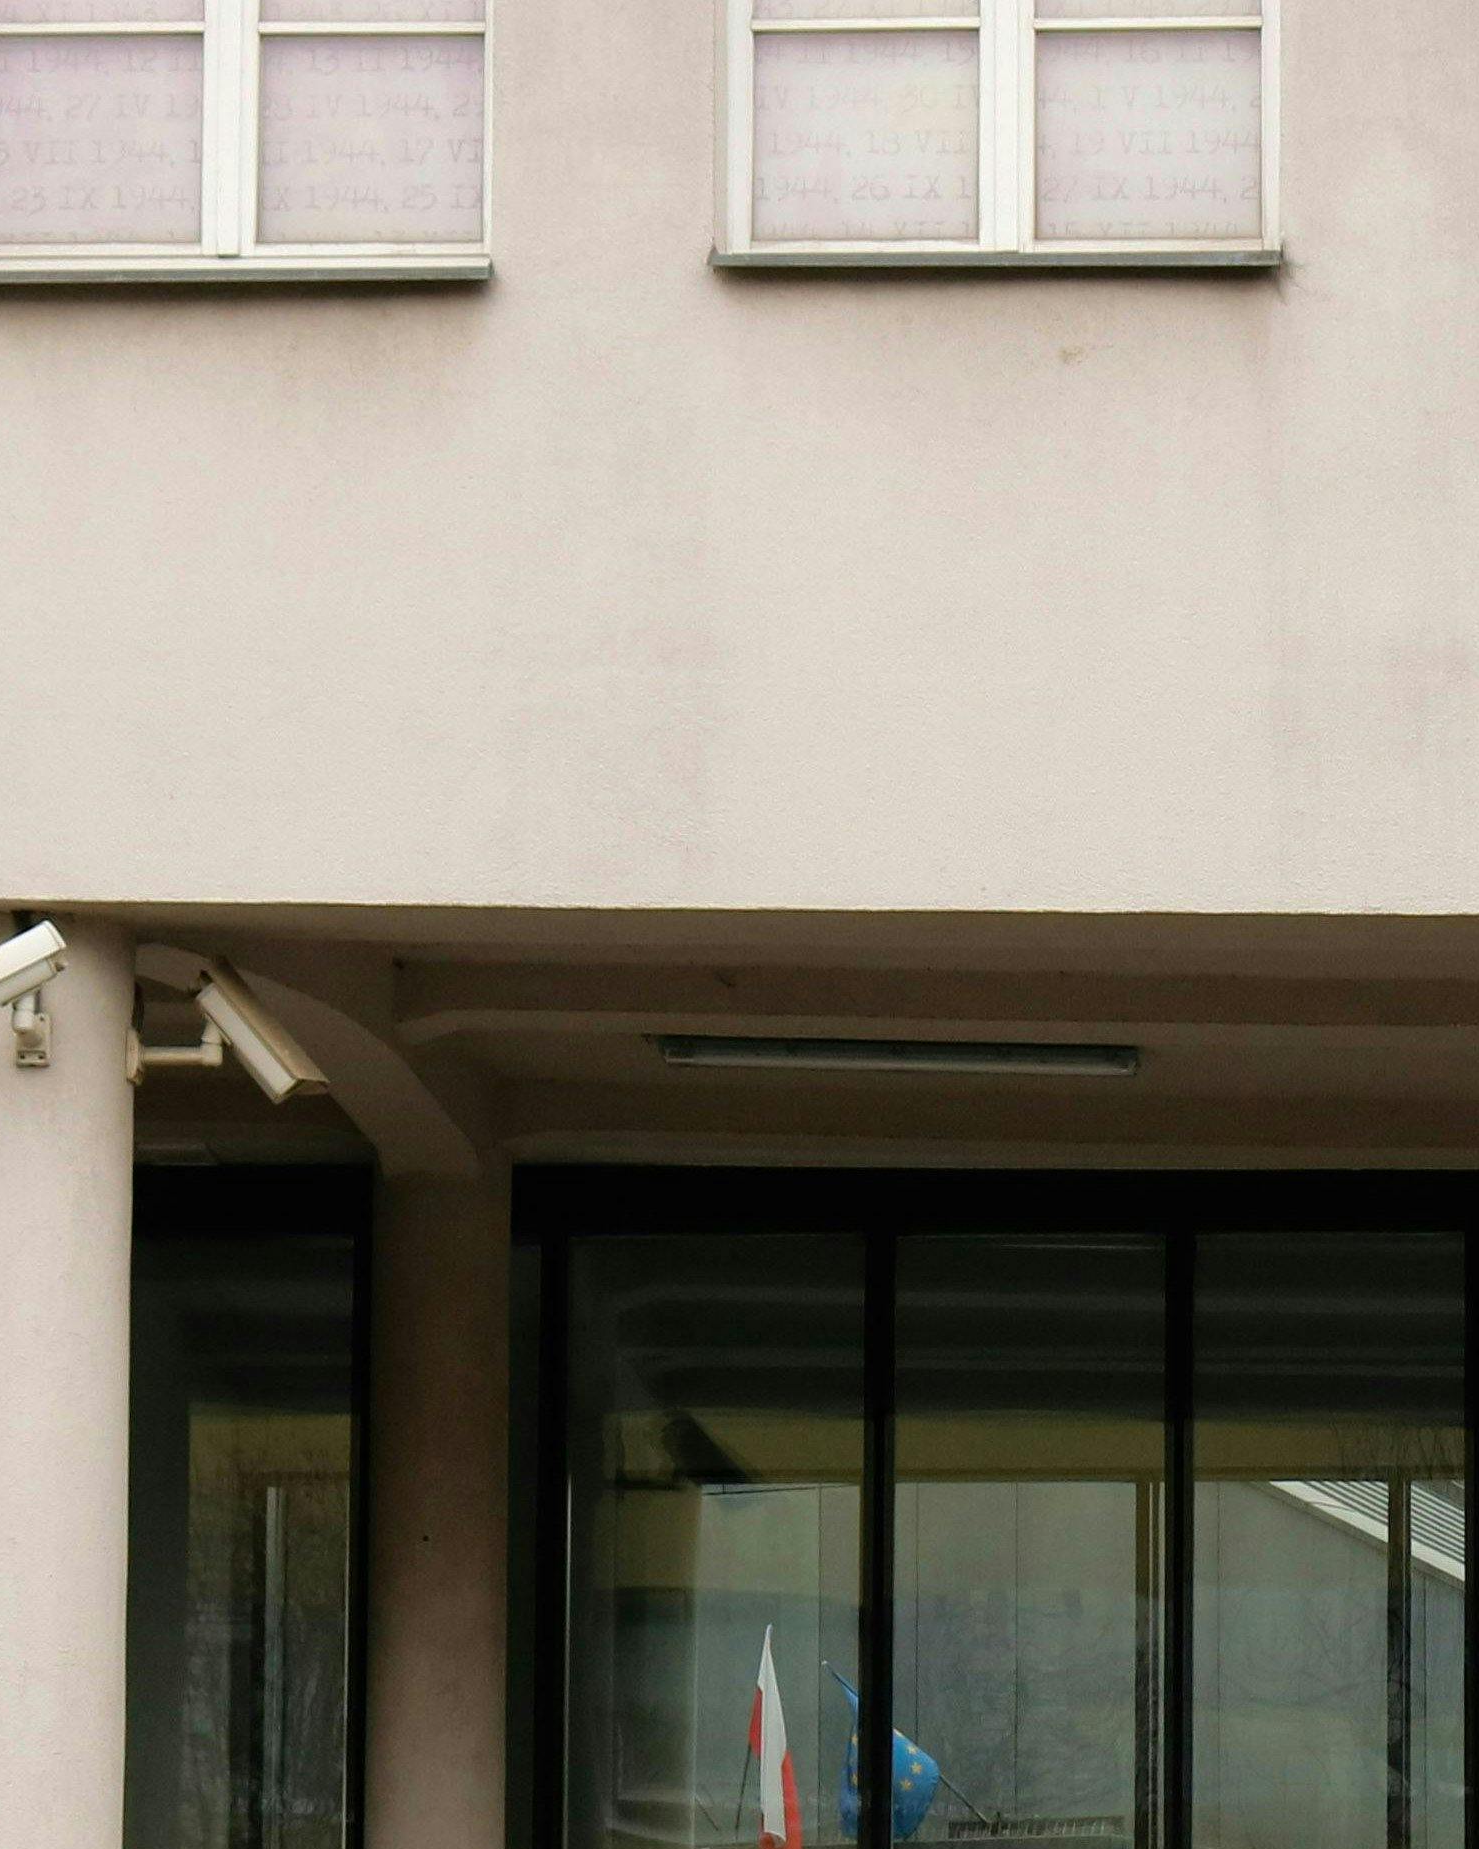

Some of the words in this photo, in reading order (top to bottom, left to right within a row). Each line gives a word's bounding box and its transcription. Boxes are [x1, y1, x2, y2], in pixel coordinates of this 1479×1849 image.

[64, 93, 102, 121] 27
[113, 92, 152, 118] IV
[306, 93, 343, 119] IV
[1091, 84, 1107, 110] 1
[1121, 84, 1141, 109] V
[23, 139, 78, 164] VII
[399, 138, 434, 166] 17
[913, 129, 968, 154] VII
[1070, 131, 1106, 155] 19
[1116, 129, 1173, 155] VII
[10, 186, 47, 217] 23
[58, 185, 99, 211] IX
[401, 184, 439, 211] 25
[851, 174, 892, 201] 26
[901, 174, 942, 199] IX
[1043, 175, 1078, 203] 27
[1092, 175, 1130, 201] IX
